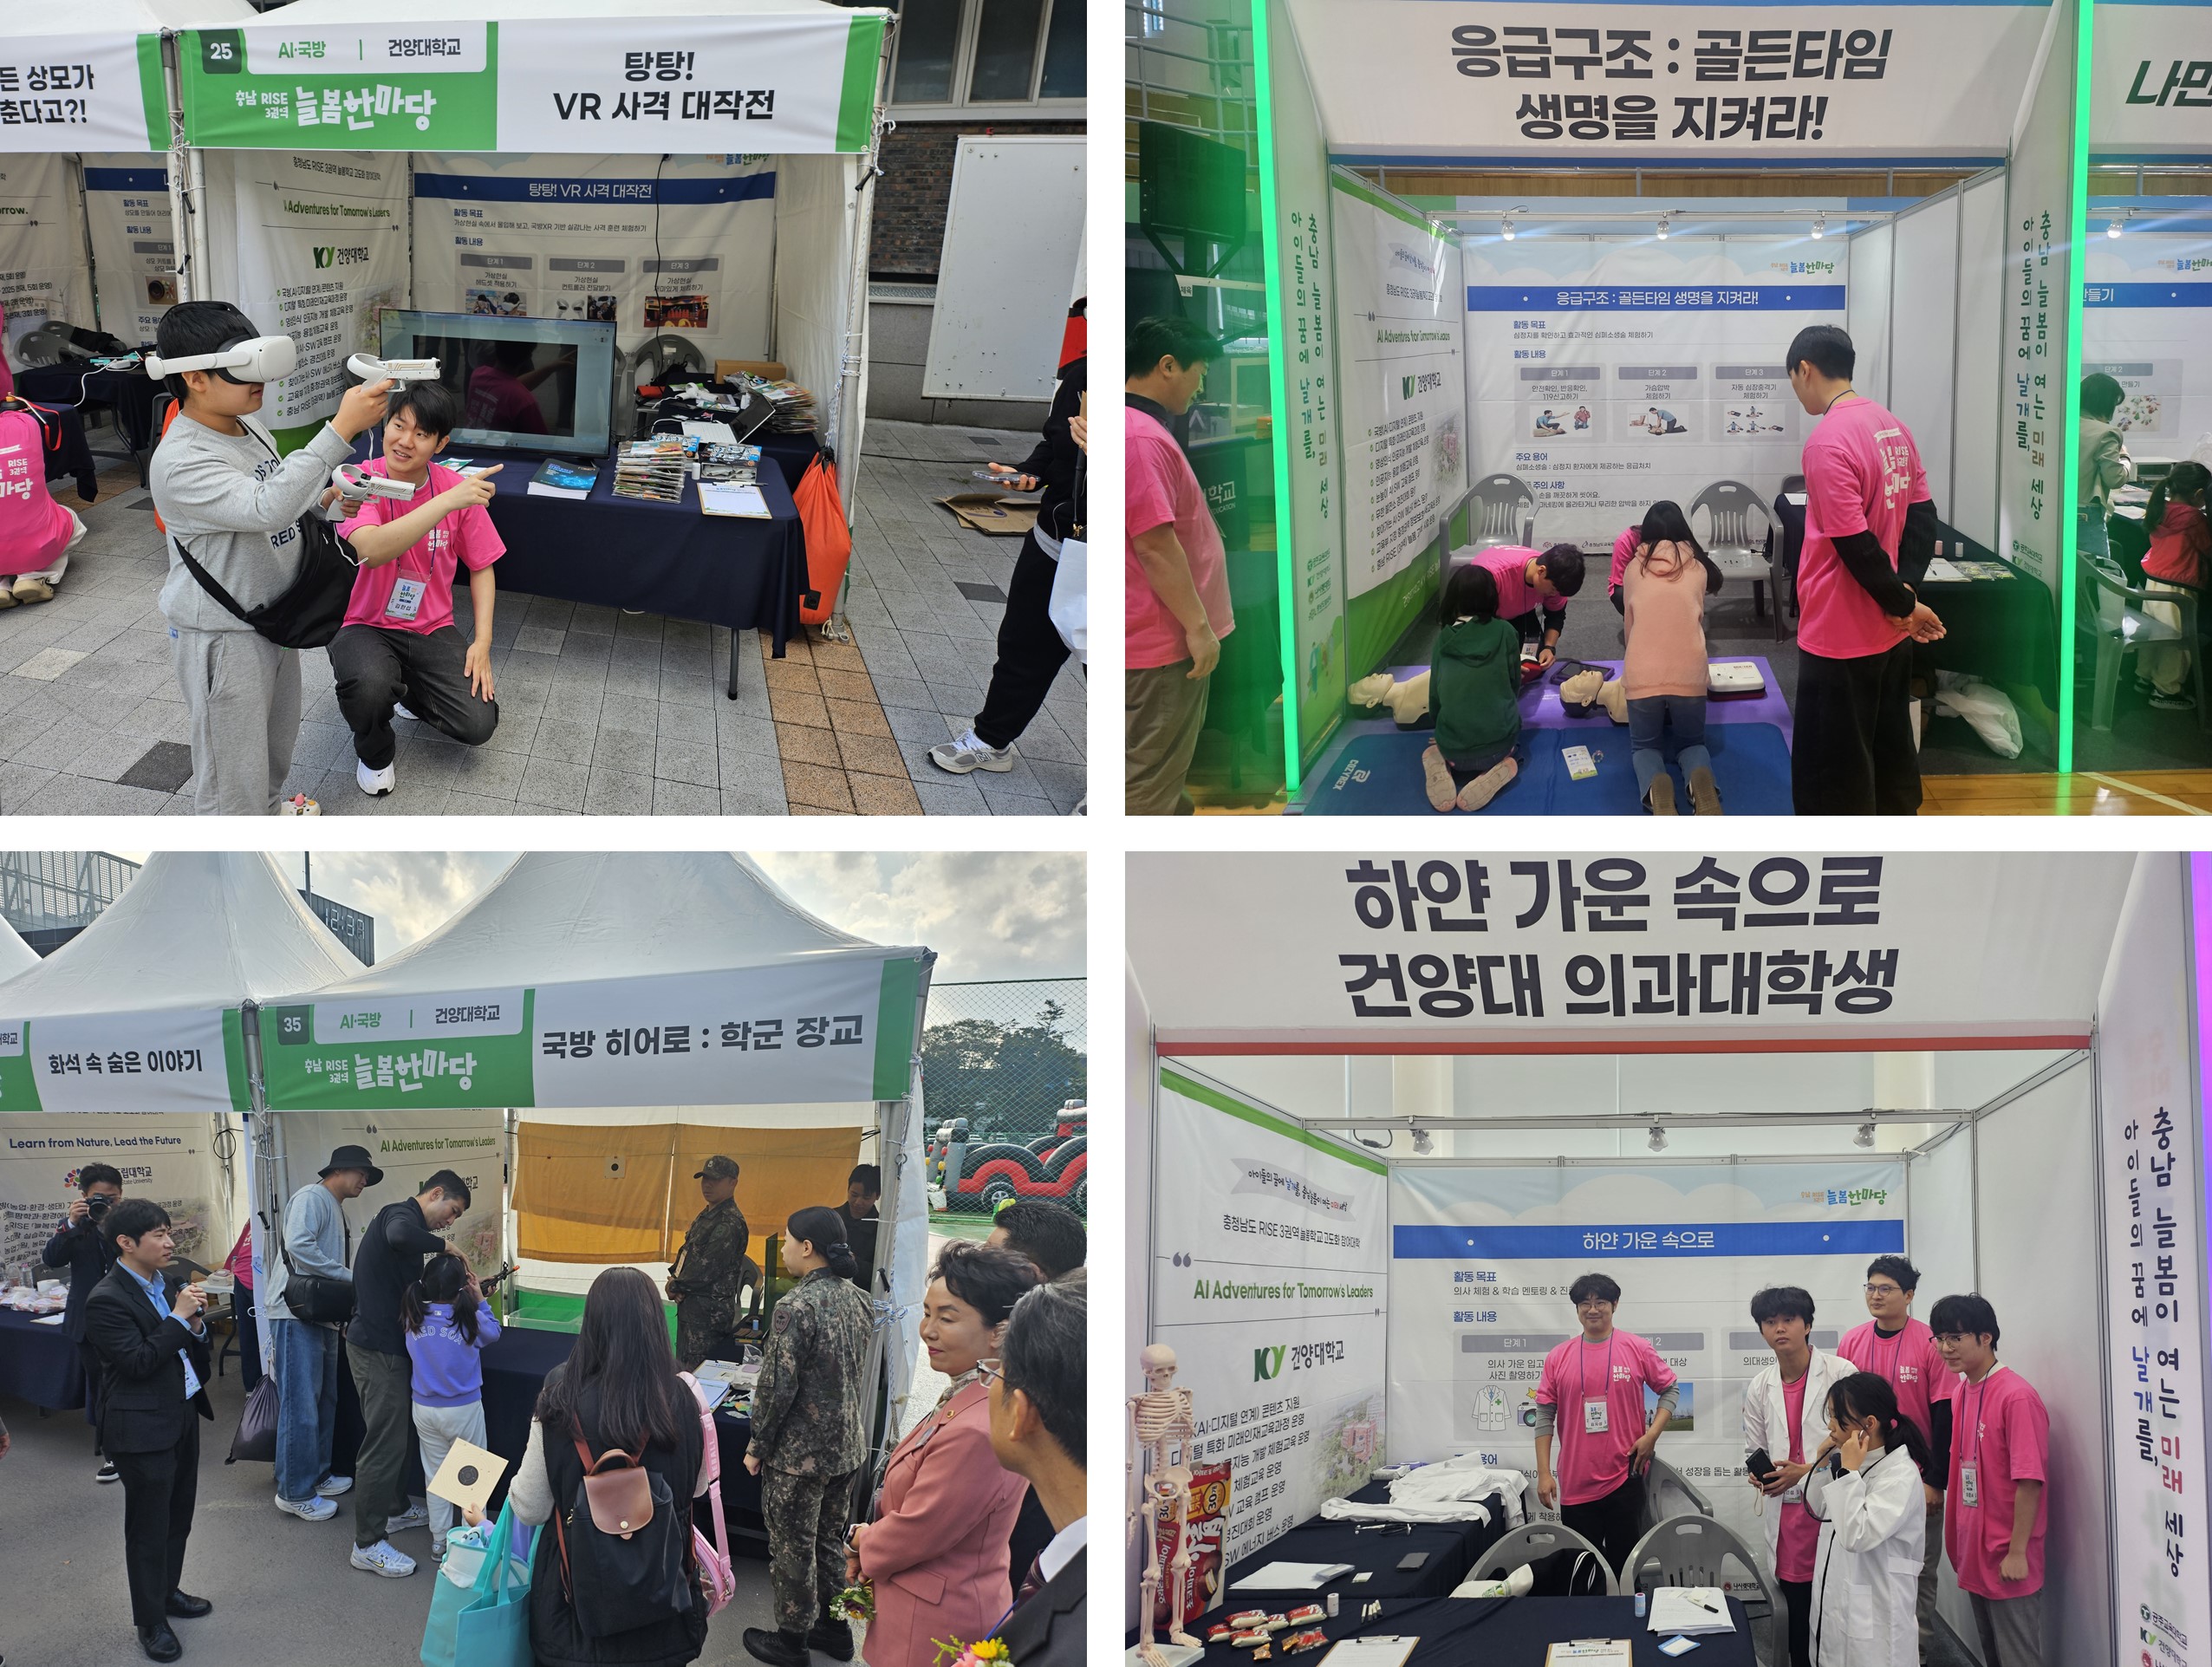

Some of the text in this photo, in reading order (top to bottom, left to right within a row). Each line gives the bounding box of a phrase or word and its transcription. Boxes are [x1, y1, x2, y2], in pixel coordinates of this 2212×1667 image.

[210, 42, 233, 60] 25
[388, 38, 461, 57] 건양대학교
[1451, 24, 1892, 81] 응급구조 골든타임
[624, 51, 695, 82] 탕탕!
[27, 64, 94, 90] 상모가
[236, 90, 289, 107] 충남 RISE
[296, 84, 437, 131] 늘봄한마당
[553, 89, 775, 121] VR 사격 대작전
[0, 99, 88, 126] 춘다고?!
[264, 106, 289, 119] 3권역
[1516, 93, 1829, 141] 생명을 지켜라!
[529, 183, 652, 199] 탕탕! VR 사격 대작전
[288, 200, 373, 218] Adventures for Tomorrow's
[453, 208, 483, 218] 활동 목표
[455, 237, 483, 246] 활동 내용
[337, 247, 369, 265] 건양대학교
[1790, 261, 1835, 275] 늘봄한마당
[1557, 290, 1759, 305] 응급구조 골든타임 생명을 지켜라!
[1513, 321, 1545, 329] 활동 목표
[1513, 349, 1546, 359] 활동 내용
[2031, 210, 2051, 520] 충남 여는 미래 세상
[1417, 372, 1441, 394] 건양대학교
[1516, 453, 1548, 461] 주요 용어
[1895, 446, 1909, 456] RISE
[8, 458, 28, 468] RISE
[1532, 481, 1565, 490] 주의 사항
[270, 527, 296, 550] RED
[1333, 759, 1359, 791] COZYREX
[1345, 856, 1883, 932] 하얀 가운 속으로
[1338, 948, 1900, 1018] 건양대 의과대학생
[283, 1017, 302, 1032] 35
[435, 1005, 500, 1025] 건양대학교
[542, 1014, 863, 1059] 국방 히어로 학군 장교
[48, 1049, 203, 1075] 화석 속 숨은 이야기
[304, 1058, 348, 1074] 충남 RISE
[354, 1048, 478, 1093] 늘봄한마당
[329, 1072, 348, 1084] 3권역
[9, 1136, 181, 1149] Learn from Nature, Lead the Future
[381, 1136, 496, 1153] AI Adventures for Tomorrow's Leaders
[1826, 1188, 1888, 1207] 늘봄한마당
[1223, 1214, 1257, 1234] 충청남도
[1259, 1221, 1278, 1237] RISE
[1279, 1224, 1299, 1240] 3권역
[1583, 1231, 1714, 1250] 하얀 가운 속으로
[1454, 1271, 1497, 1282] 활동 목표
[1194, 1280, 1374, 1299] AI Adventures for Tomorrow's Leaders
[1454, 1286, 1547, 1296] 의사 체험 & 학습 멘토링
[2124, 1119, 2158, 1467] 아이들의 꿈에 날개를,
[1454, 1311, 1497, 1323] 활동 내용
[1504, 1338, 1520, 1347] 단계
[2151, 1106, 2183, 1578] 충남 늘봄이 여는 미래 세상
[1254, 1340, 1344, 1382] KY 건양대학교
[1487, 1360, 1545, 1369] 의사 가운 입고
[1669, 1358, 1688, 1367] 대상
[1489, 1371, 1506, 1380] 사진
[1240, 1397, 1300, 1423] 연계) 콘텐츠 지원
[1206, 1413, 1305, 1455] 특화 미래인재교육과정 운영
[1252, 1430, 1311, 1462] 개발 체험교육 운영
[1233, 1468, 1265, 1492] 체험교육
[1266, 1461, 1283, 1478] 운영
[1686, 1467, 1731, 1476] 성장을 돕는
[1236, 1495, 1253, 1513] 교육
[1271, 1480, 1286, 1498] 운영
[1256, 1507, 1273, 1527] 운영
[1241, 1534, 1265, 1555] 에너지
[1266, 1526, 1280, 1542] 버스
[1280, 1514, 1294, 1533] 운영
